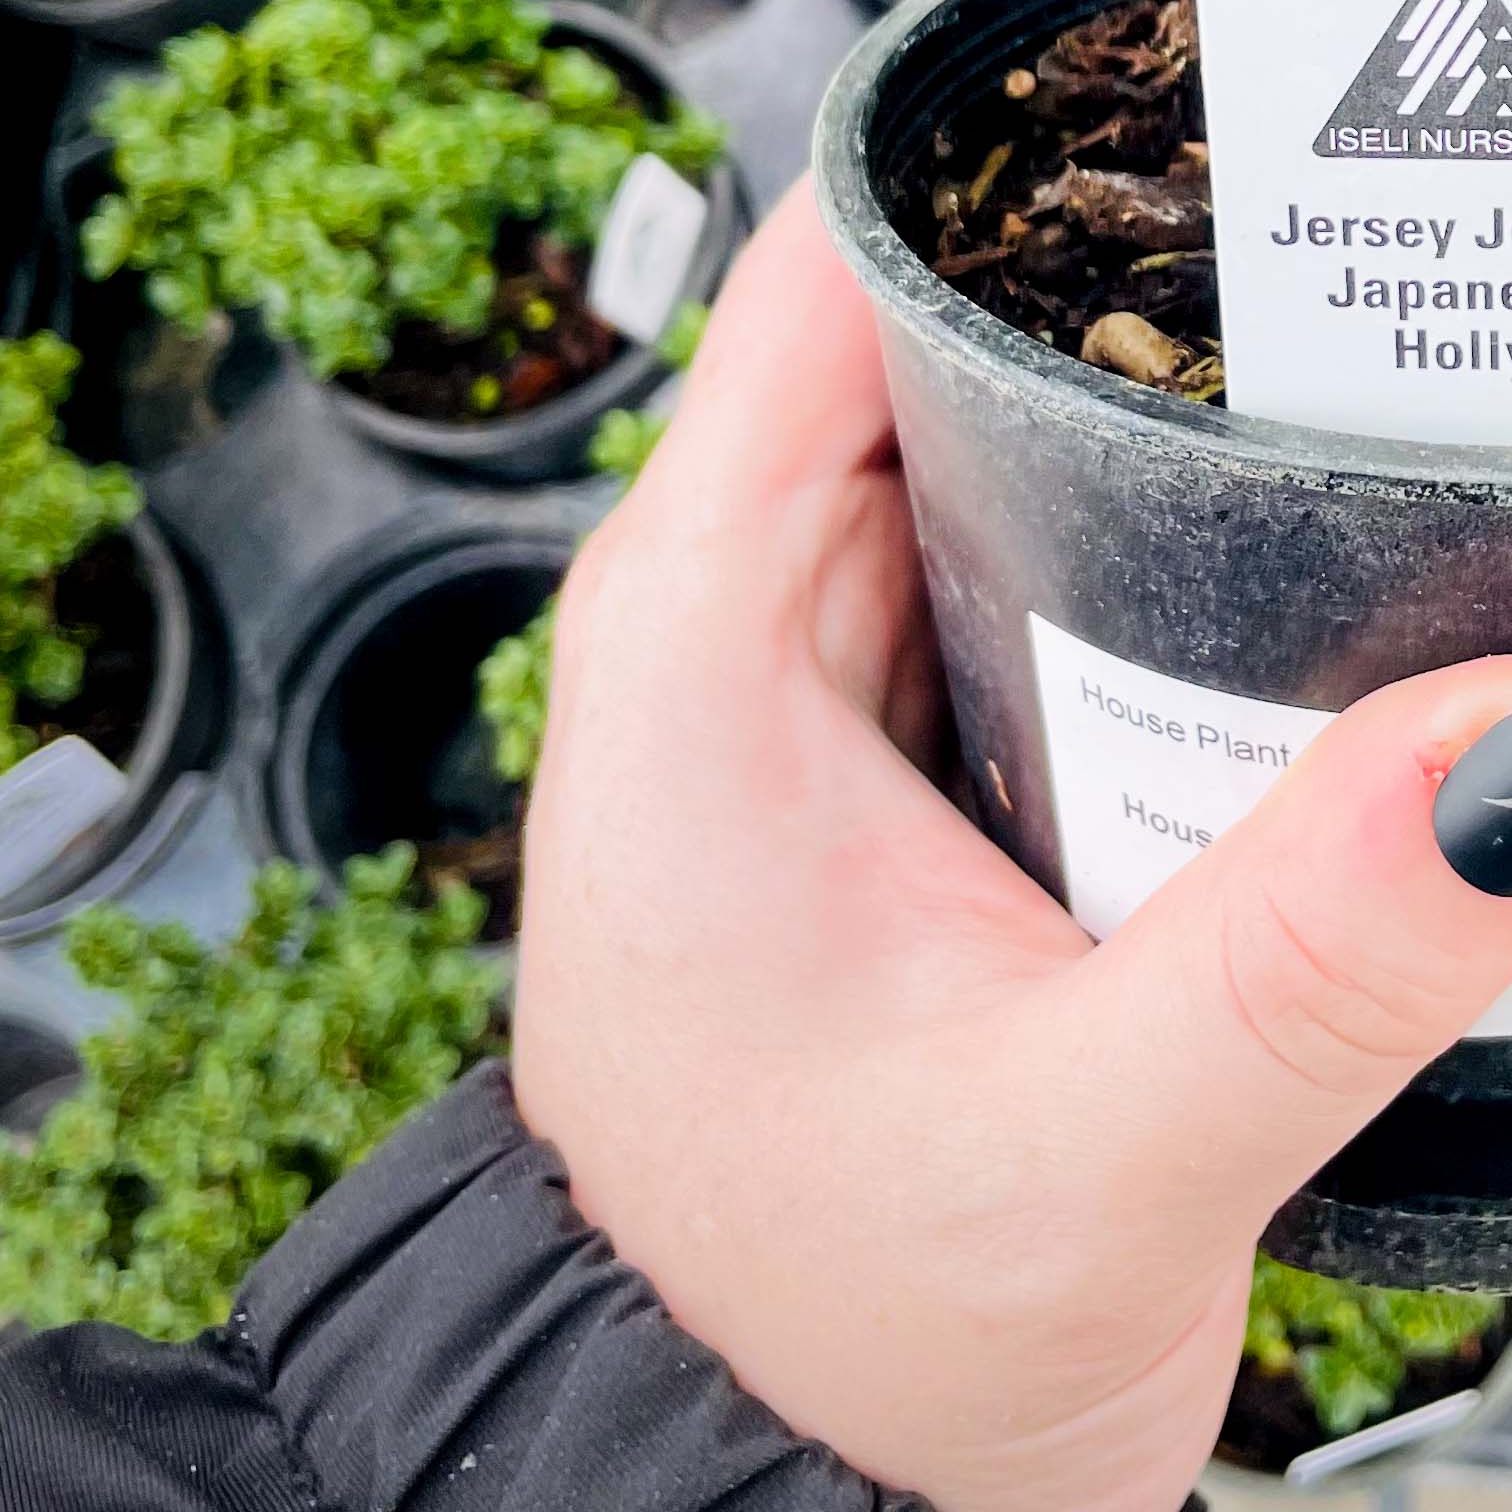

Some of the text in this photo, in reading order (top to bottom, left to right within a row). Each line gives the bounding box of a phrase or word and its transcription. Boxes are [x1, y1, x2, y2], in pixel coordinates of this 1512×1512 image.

[1328, 127, 1410, 153] ISELI
[1270, 203, 1457, 259] Jersey
[1080, 676, 1292, 768] House Plant
